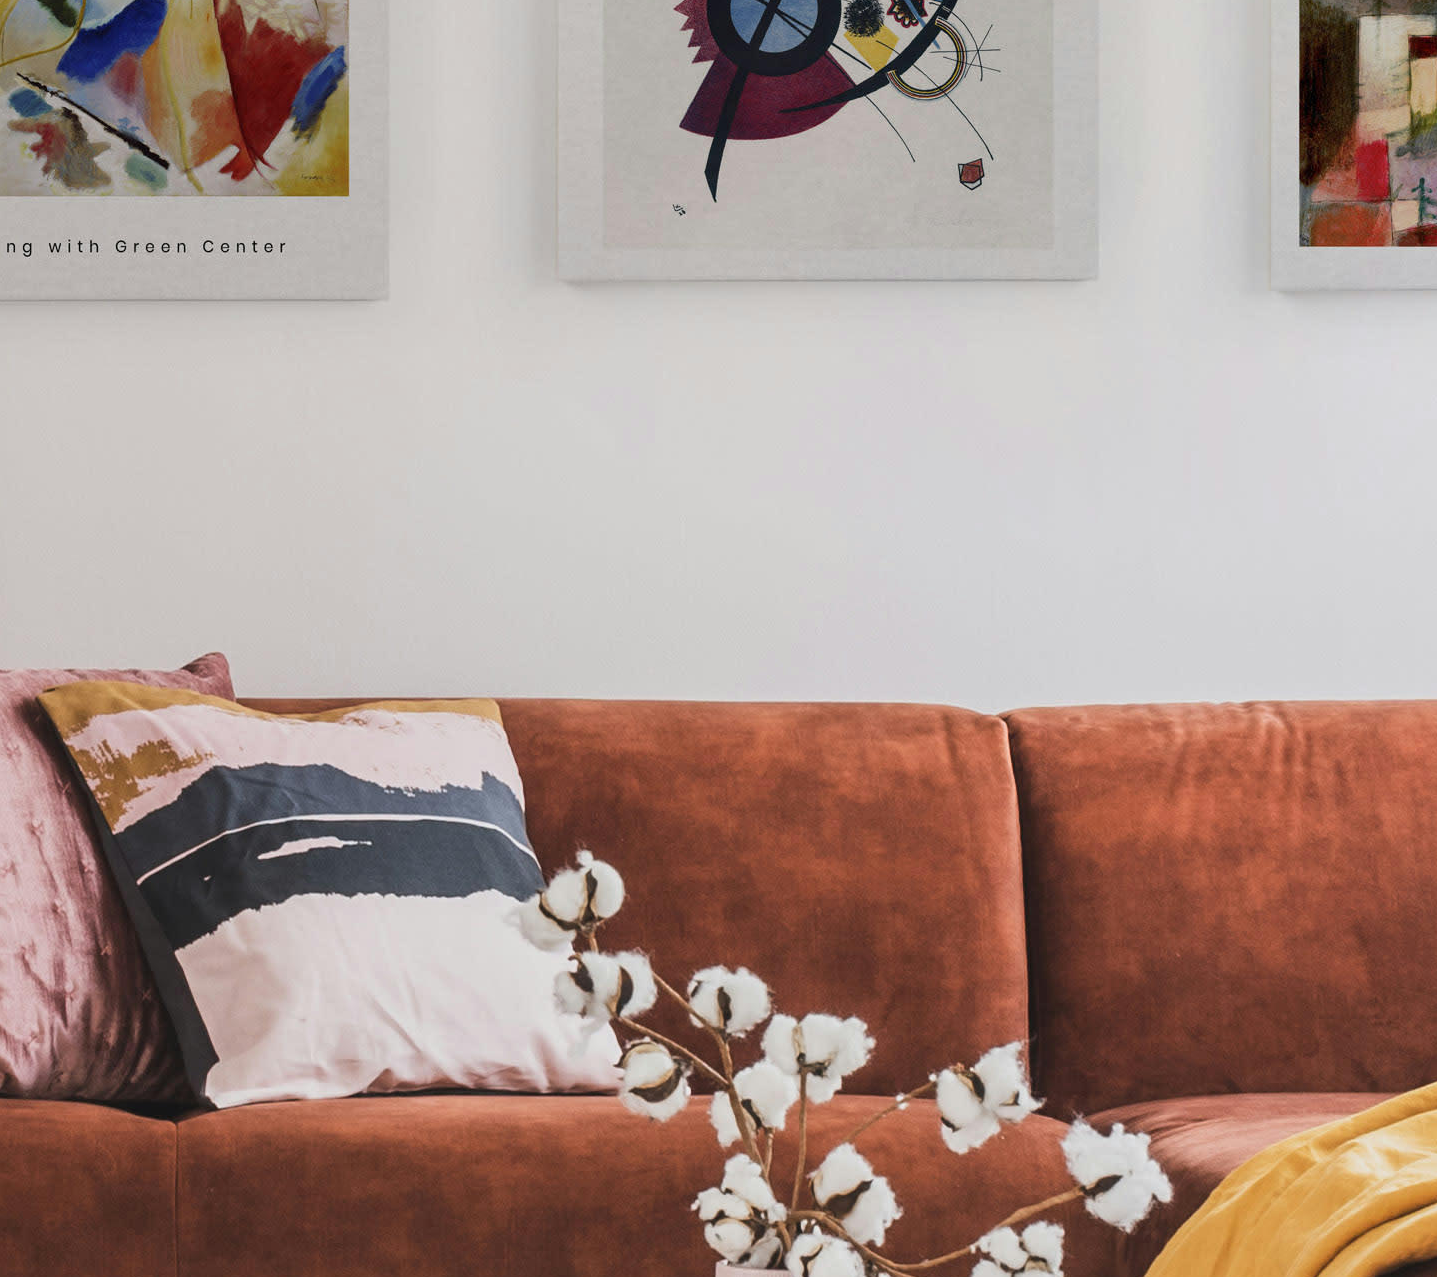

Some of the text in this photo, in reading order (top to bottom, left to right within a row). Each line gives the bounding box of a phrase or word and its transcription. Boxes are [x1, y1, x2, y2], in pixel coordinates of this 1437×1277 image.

[48, 238, 99, 254] with
[115, 239, 187, 254] Green
[202, 239, 286, 254] Center
